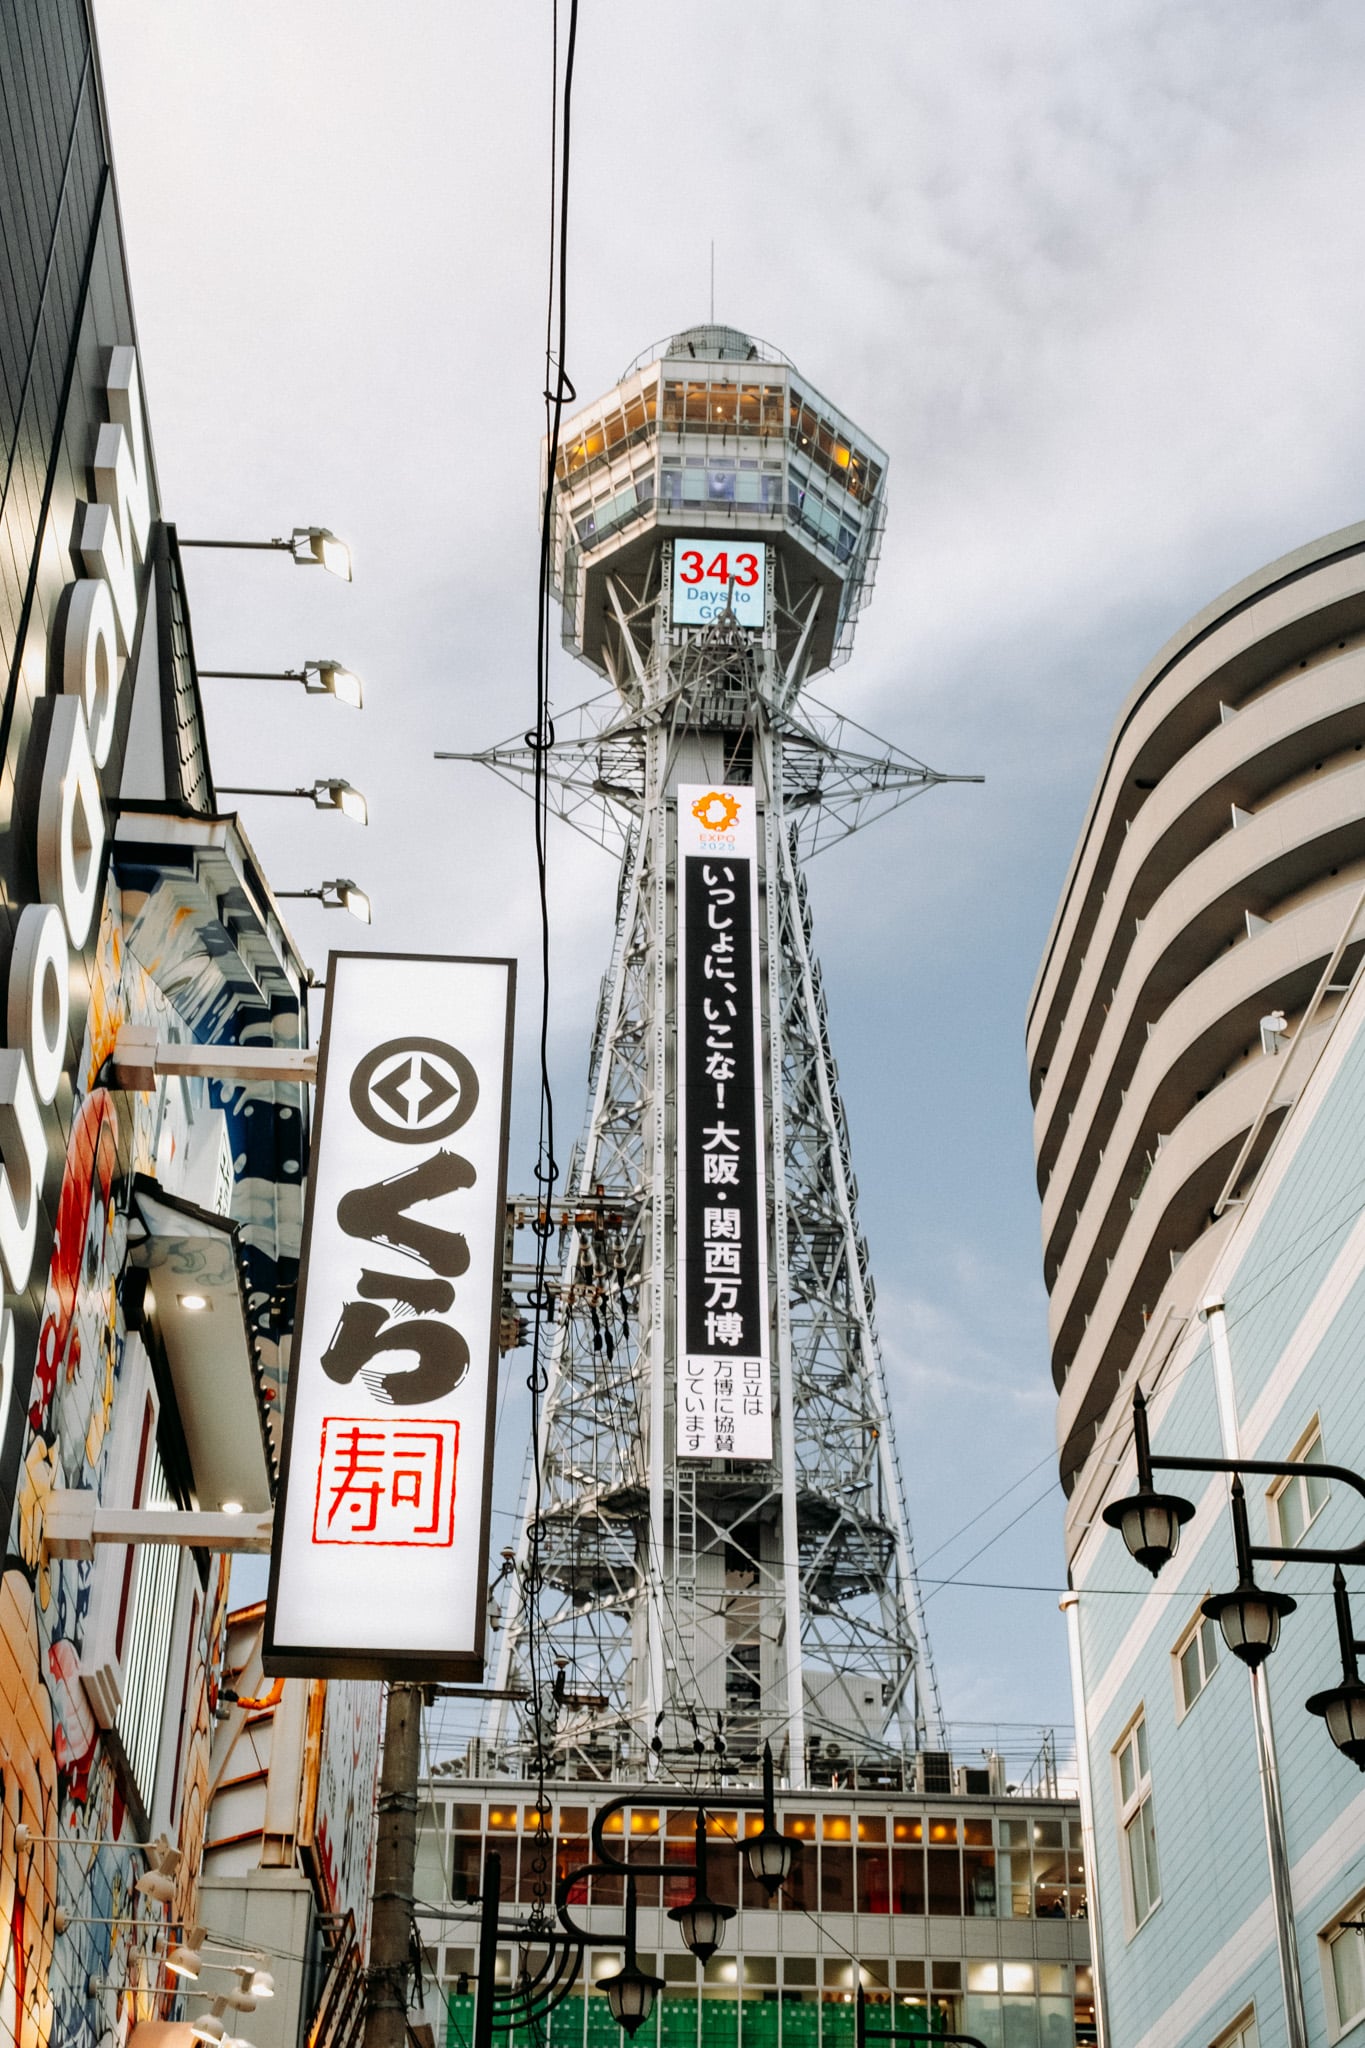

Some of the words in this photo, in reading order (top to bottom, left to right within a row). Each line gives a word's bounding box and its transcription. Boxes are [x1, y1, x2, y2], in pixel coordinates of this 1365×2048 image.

[679, 551, 759, 587] 343
[687, 588, 729, 604] Days
[735, 590, 751, 603] to
[699, 834, 736, 842] EXPO
[699, 842, 736, 851] 2025
[320, 1146, 477, 1406] くら
[684, 1359, 706, 1451] しています
[713, 1360, 735, 1453] 万博に協賛
[743, 1361, 764, 1416] 日立は
[327, 1426, 444, 1534] 寿司
